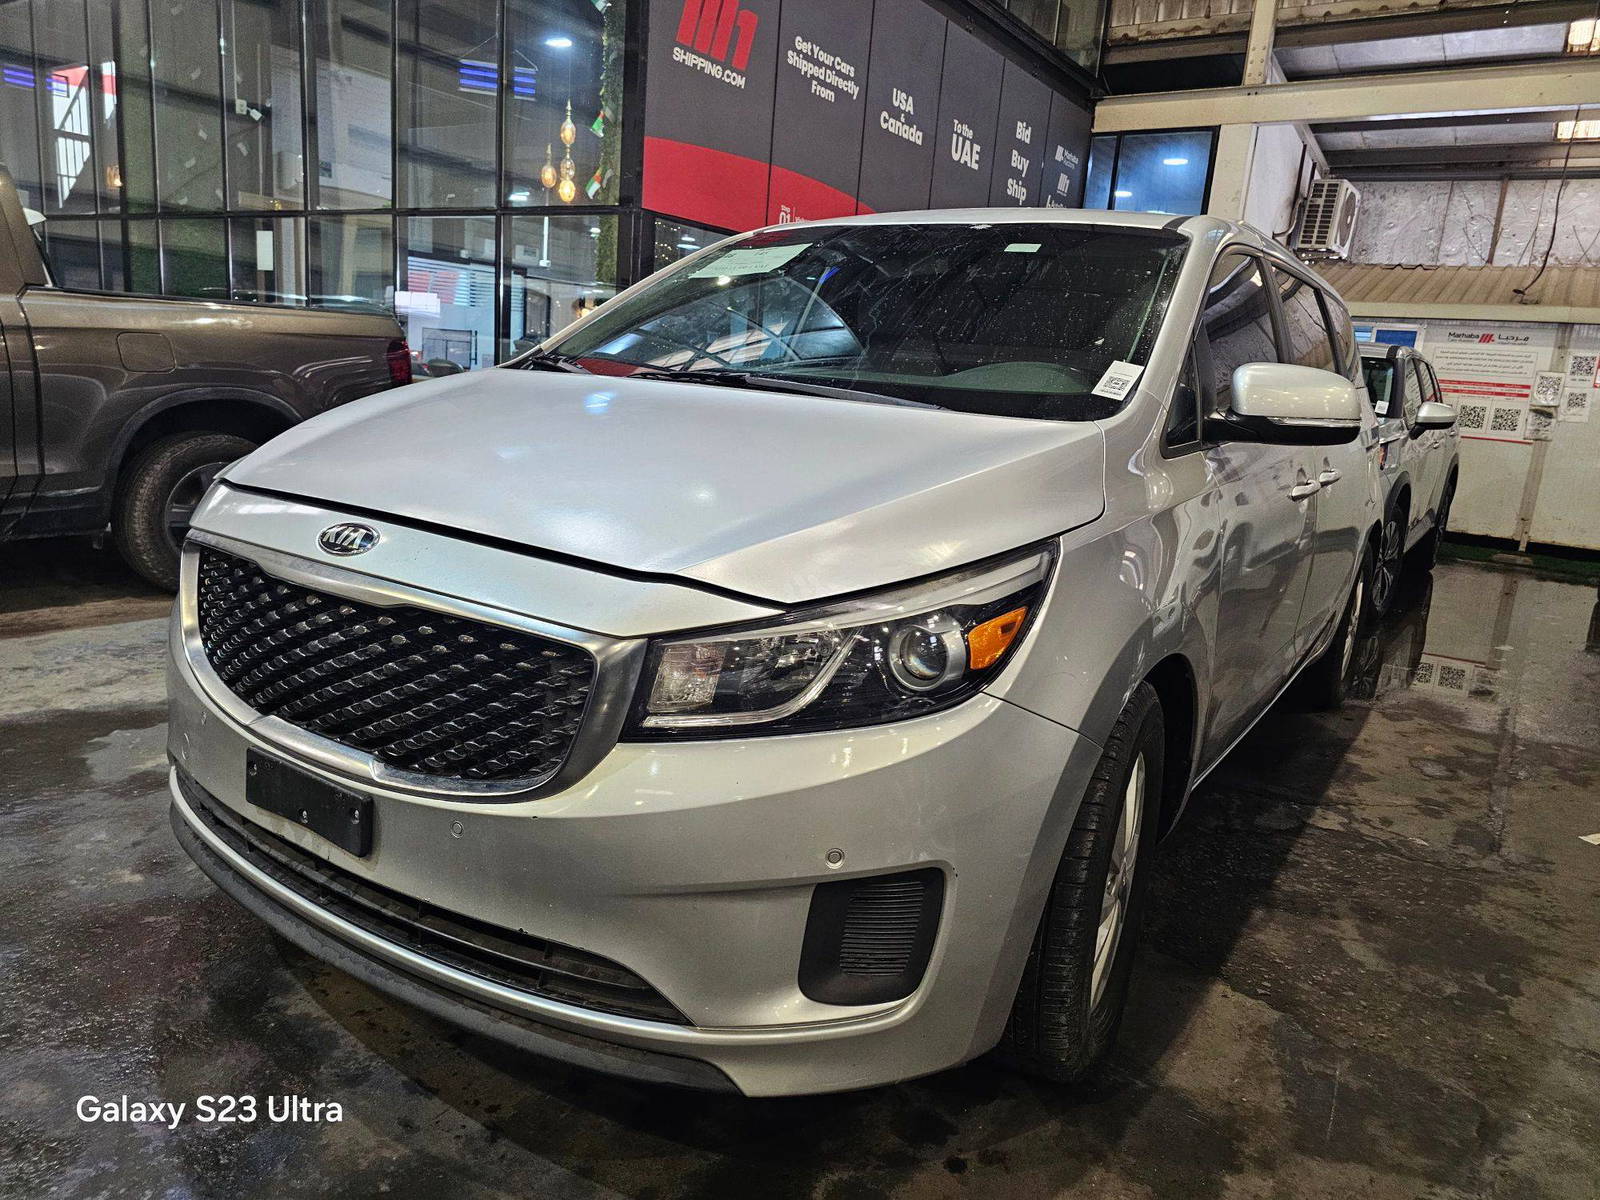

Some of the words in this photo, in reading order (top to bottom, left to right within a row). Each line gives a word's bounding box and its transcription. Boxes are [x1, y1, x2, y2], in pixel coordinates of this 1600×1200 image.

[672, 47, 747, 89] SHIPPING.COM
[795, 36, 812, 56] Get
[813, 44, 835, 67] Your
[834, 56, 855, 77] Cars
[787, 50, 826, 80] Shipped
[825, 69, 860, 100] Directly
[811, 80, 835, 102] From
[892, 88, 914, 115] USA
[880, 111, 923, 146] Canada
[953, 119, 962, 134] To
[961, 123, 974, 139] the
[1016, 121, 1032, 145] Bid
[951, 133, 981, 170] UAE
[1011, 149, 1030, 178] Buy
[1006, 178, 1027, 206] Ship
[1447, 331, 1480, 339] Marhaba
